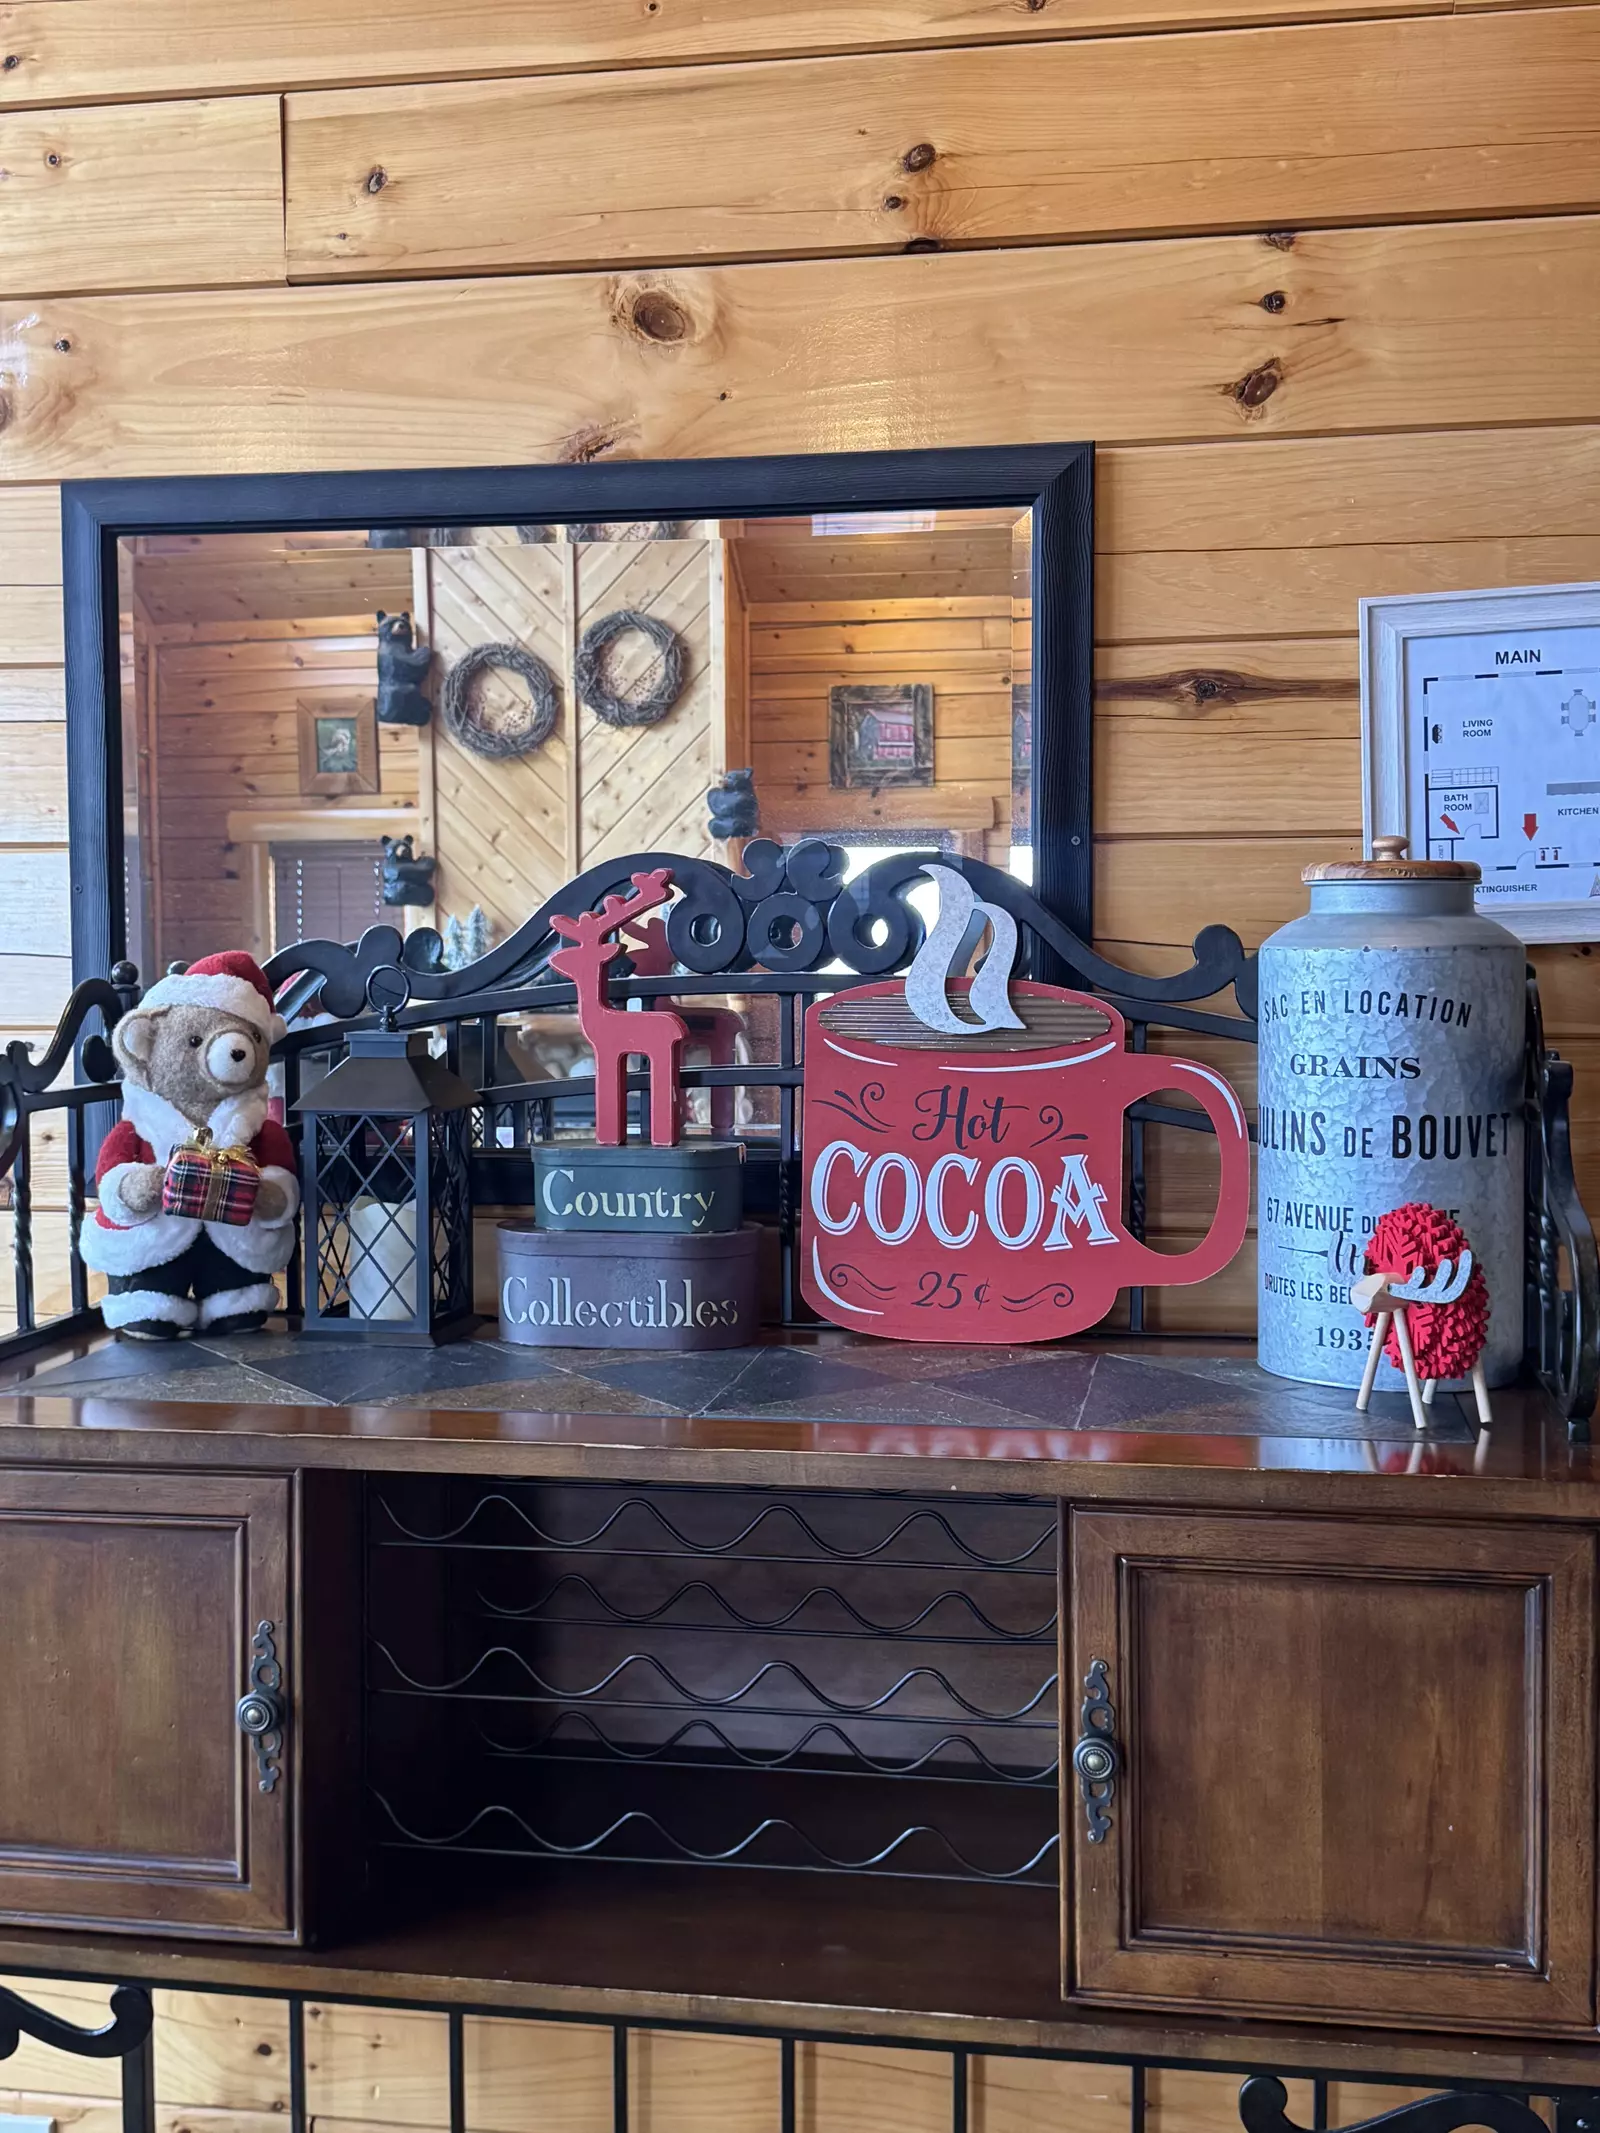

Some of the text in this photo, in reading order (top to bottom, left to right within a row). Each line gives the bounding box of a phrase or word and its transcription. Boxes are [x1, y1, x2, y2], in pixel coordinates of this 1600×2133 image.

[1494, 649, 1542, 665] MAIN
[1462, 719, 1494, 728] LIVING
[1462, 729, 1492, 738] ROOM
[1443, 794, 1469, 802] BATH
[1443, 803, 1473, 812] ROOM
[1557, 807, 1600, 816] KITCHEN
[1474, 883, 1538, 894] XTINGUISHER
[1264, 989, 1472, 1028] SAC EN LOCATION
[1290, 1053, 1421, 1080] GRAINS
[911, 1085, 1030, 1150] Hot
[1344, 1126, 1374, 1158] DE
[1392, 1111, 1512, 1161] BOUVET
[542, 1169, 715, 1227] Country
[810, 1140, 1120, 1252] COCOA
[1267, 1197, 1280, 1224] 67
[1284, 1201, 1355, 1233] AVENUE
[502, 1276, 738, 1329] Collectibles
[911, 1271, 992, 1311] 25¢
[1301, 1281, 1323, 1302] LES
